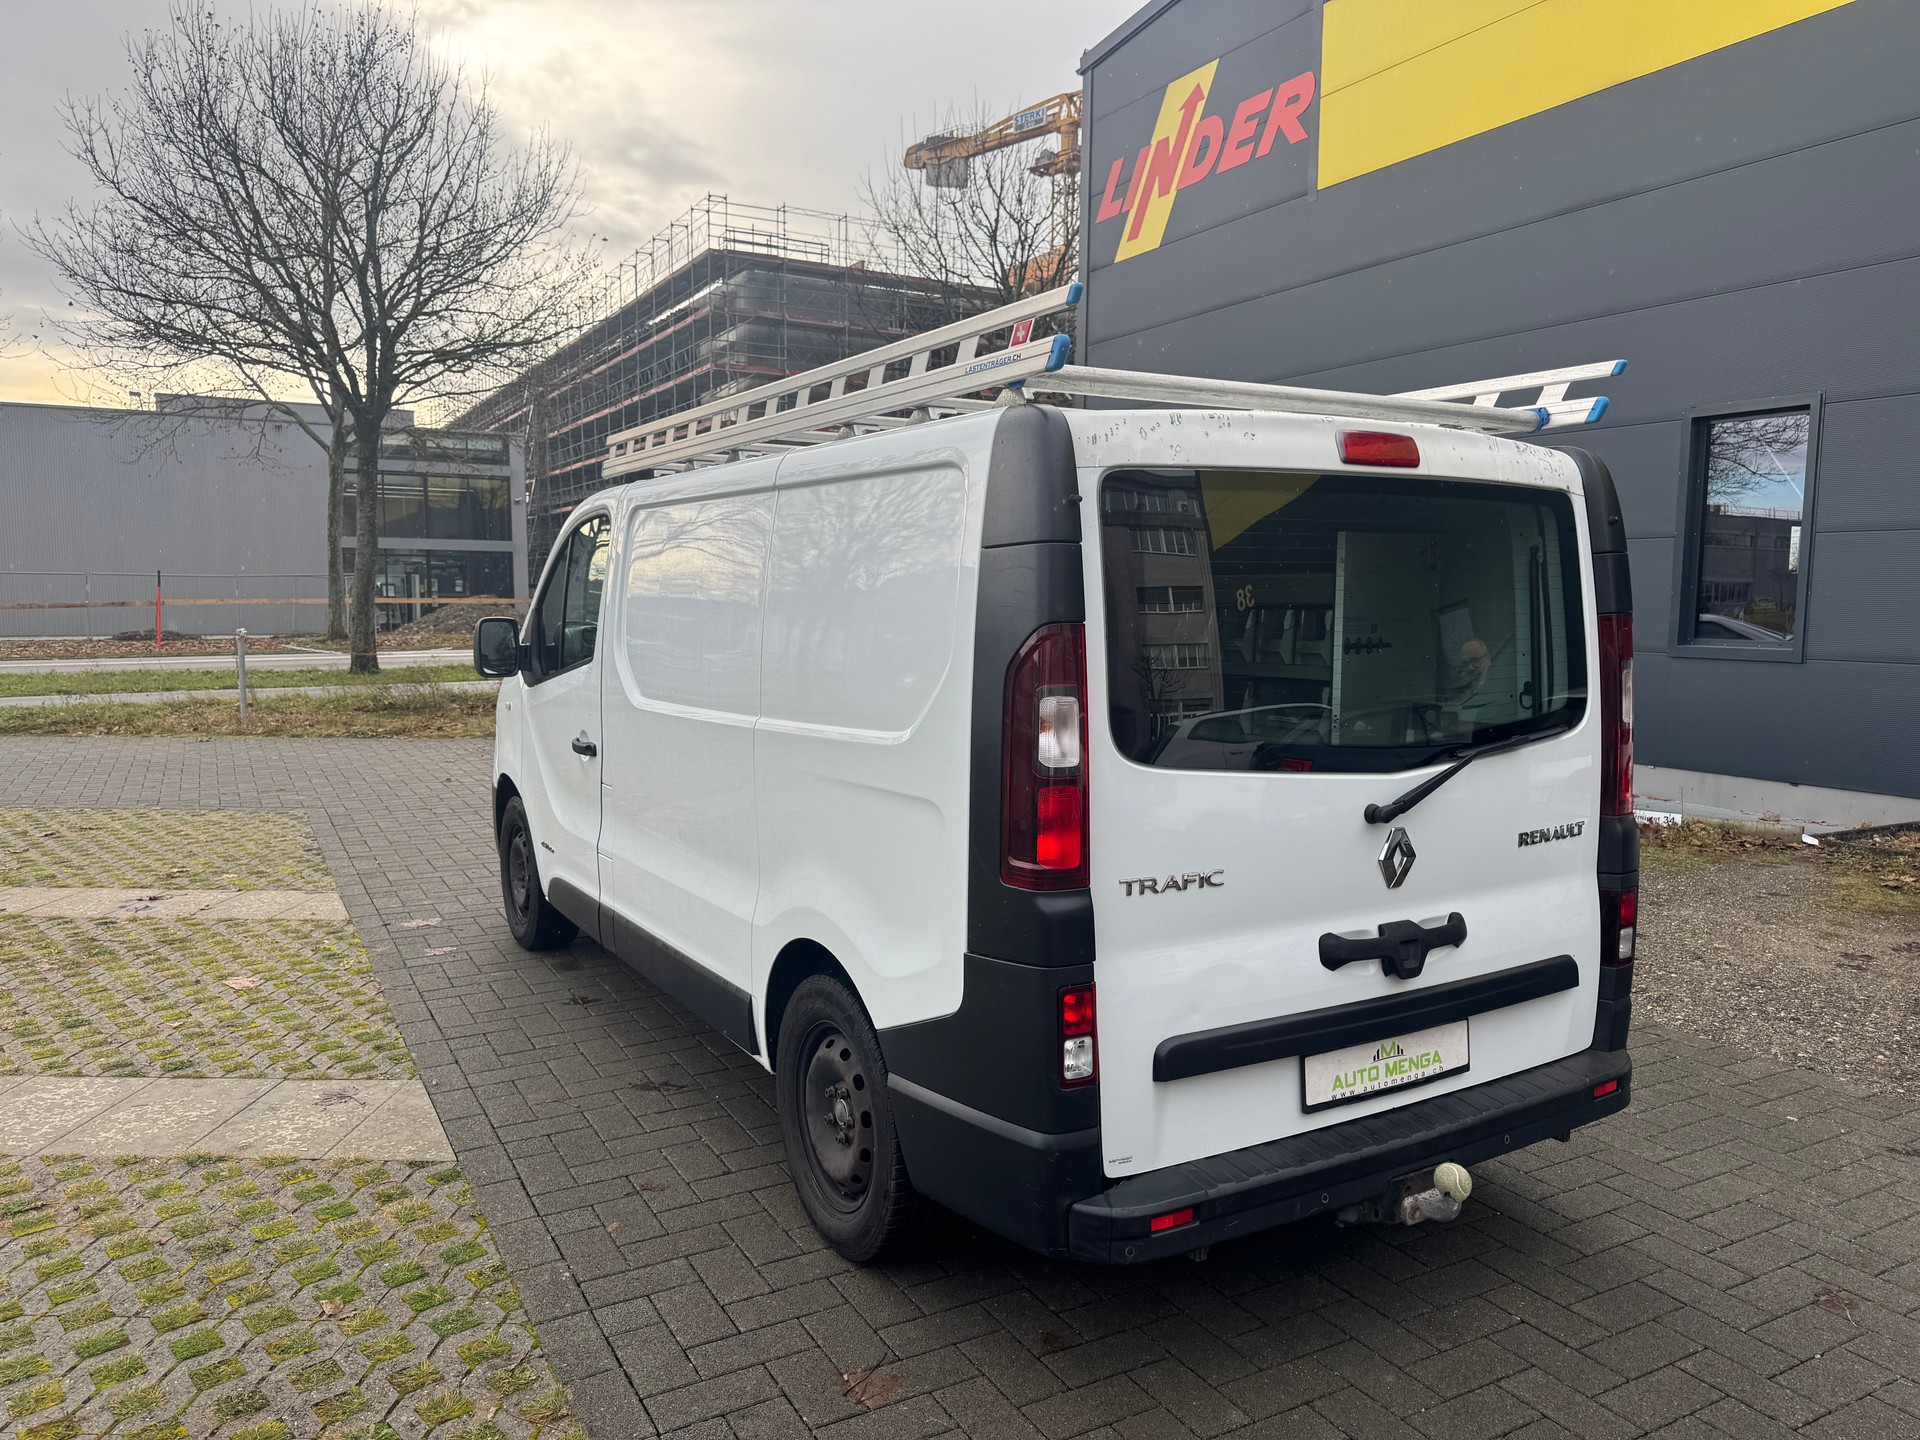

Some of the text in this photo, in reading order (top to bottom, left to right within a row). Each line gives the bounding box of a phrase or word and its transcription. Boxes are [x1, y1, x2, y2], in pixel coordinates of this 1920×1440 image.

[1096, 71, 1316, 242] LINDER
[1517, 820, 1585, 848] RENAULT
[1118, 868, 1225, 897] TRAFIC
[1331, 1050, 1443, 1092] AUTO MENGA
[1331, 1065, 1444, 1100] www.automenga.ch
